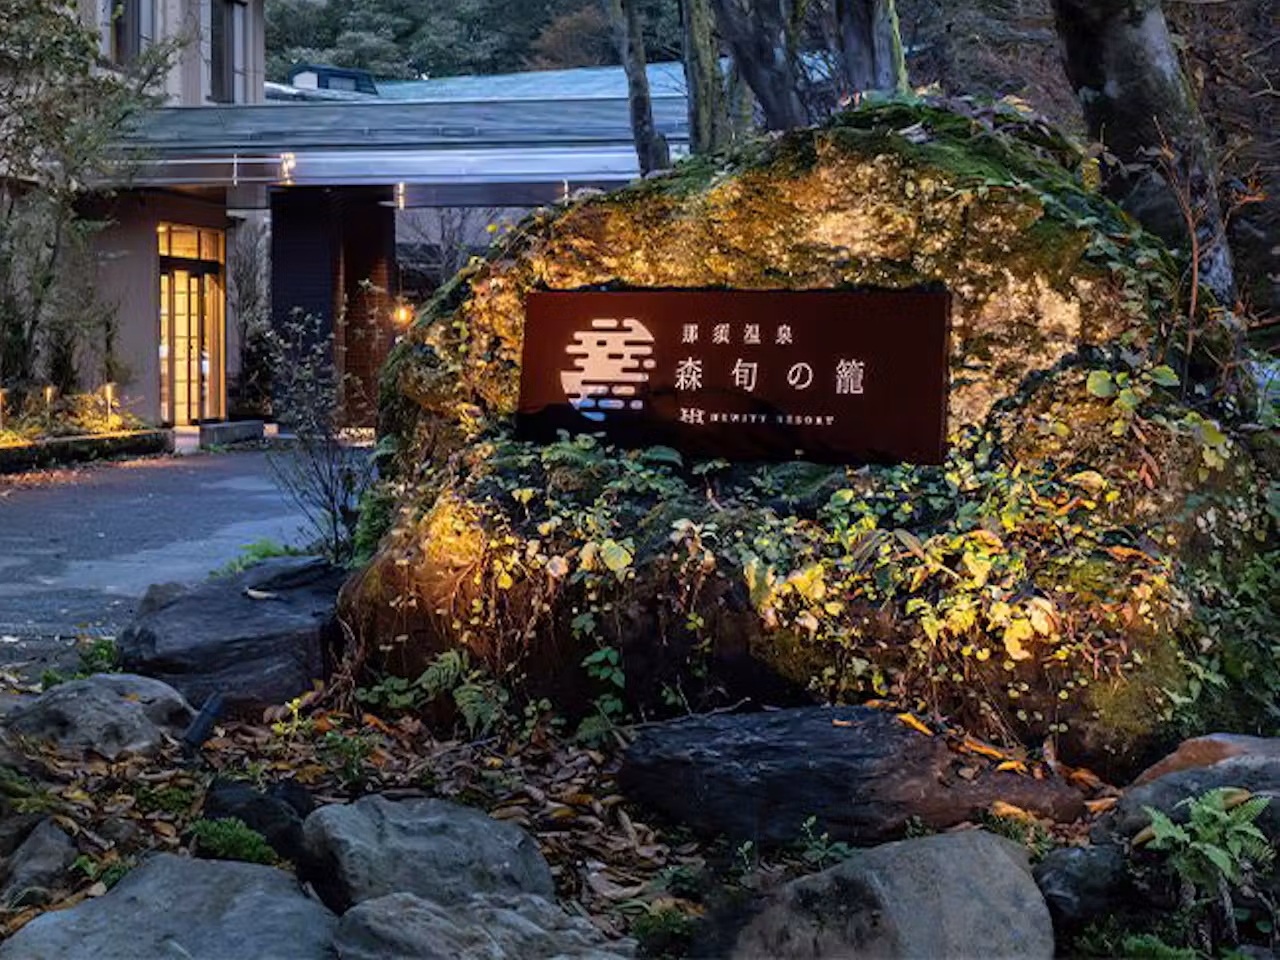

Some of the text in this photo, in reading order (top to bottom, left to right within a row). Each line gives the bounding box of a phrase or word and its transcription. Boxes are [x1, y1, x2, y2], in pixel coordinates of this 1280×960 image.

[681, 323, 793, 344] 那須温泉
[674, 357, 865, 394] 森旬の籠
[776, 415, 835, 425] RESORT
